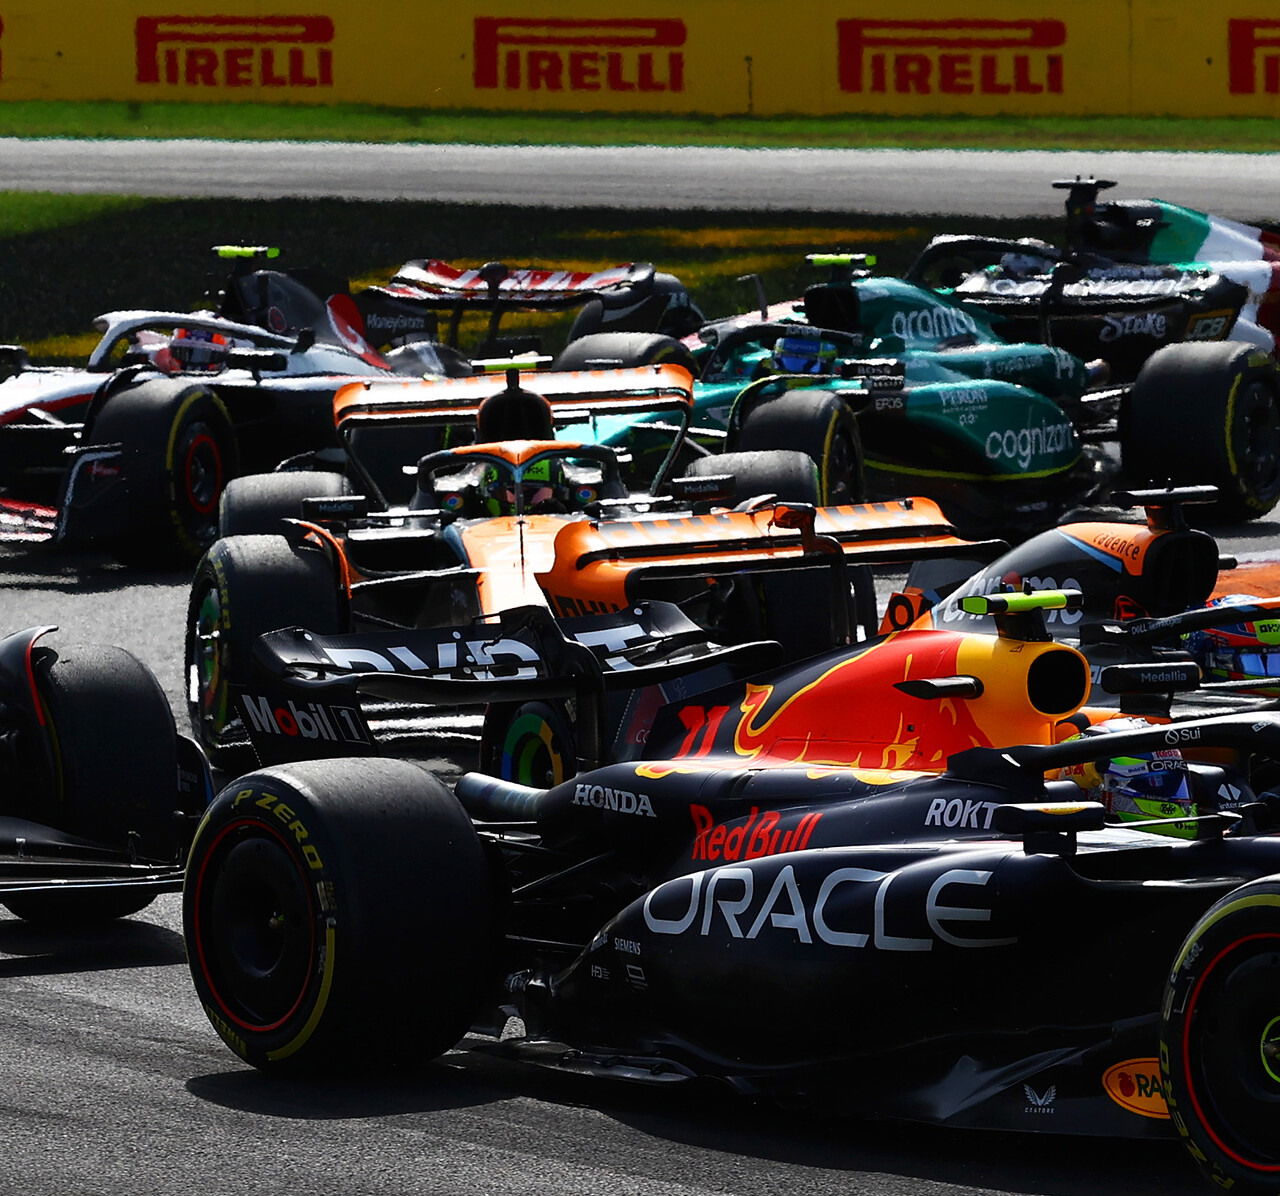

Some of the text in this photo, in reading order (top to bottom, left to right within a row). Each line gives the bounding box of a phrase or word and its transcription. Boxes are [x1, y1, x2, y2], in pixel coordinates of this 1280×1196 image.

[135, 16, 334, 87] PIRELLI
[474, 17, 688, 92] PIRELLI
[838, 19, 1067, 94] PIRELLI
[1093, 532, 1141, 562] cadence
[324, 623, 647, 681] BYBT
[1140, 670, 1187, 683] Medallia
[242, 694, 362, 742] Mobil 1
[1180, 727, 1201, 742] Sui
[572, 784, 657, 818] HONDA
[924, 798, 997, 830] ROKT
[689, 802, 824, 861] Red Bull
[643, 864, 1018, 952] ORACLE
[613, 937, 641, 955] SIEMENS
